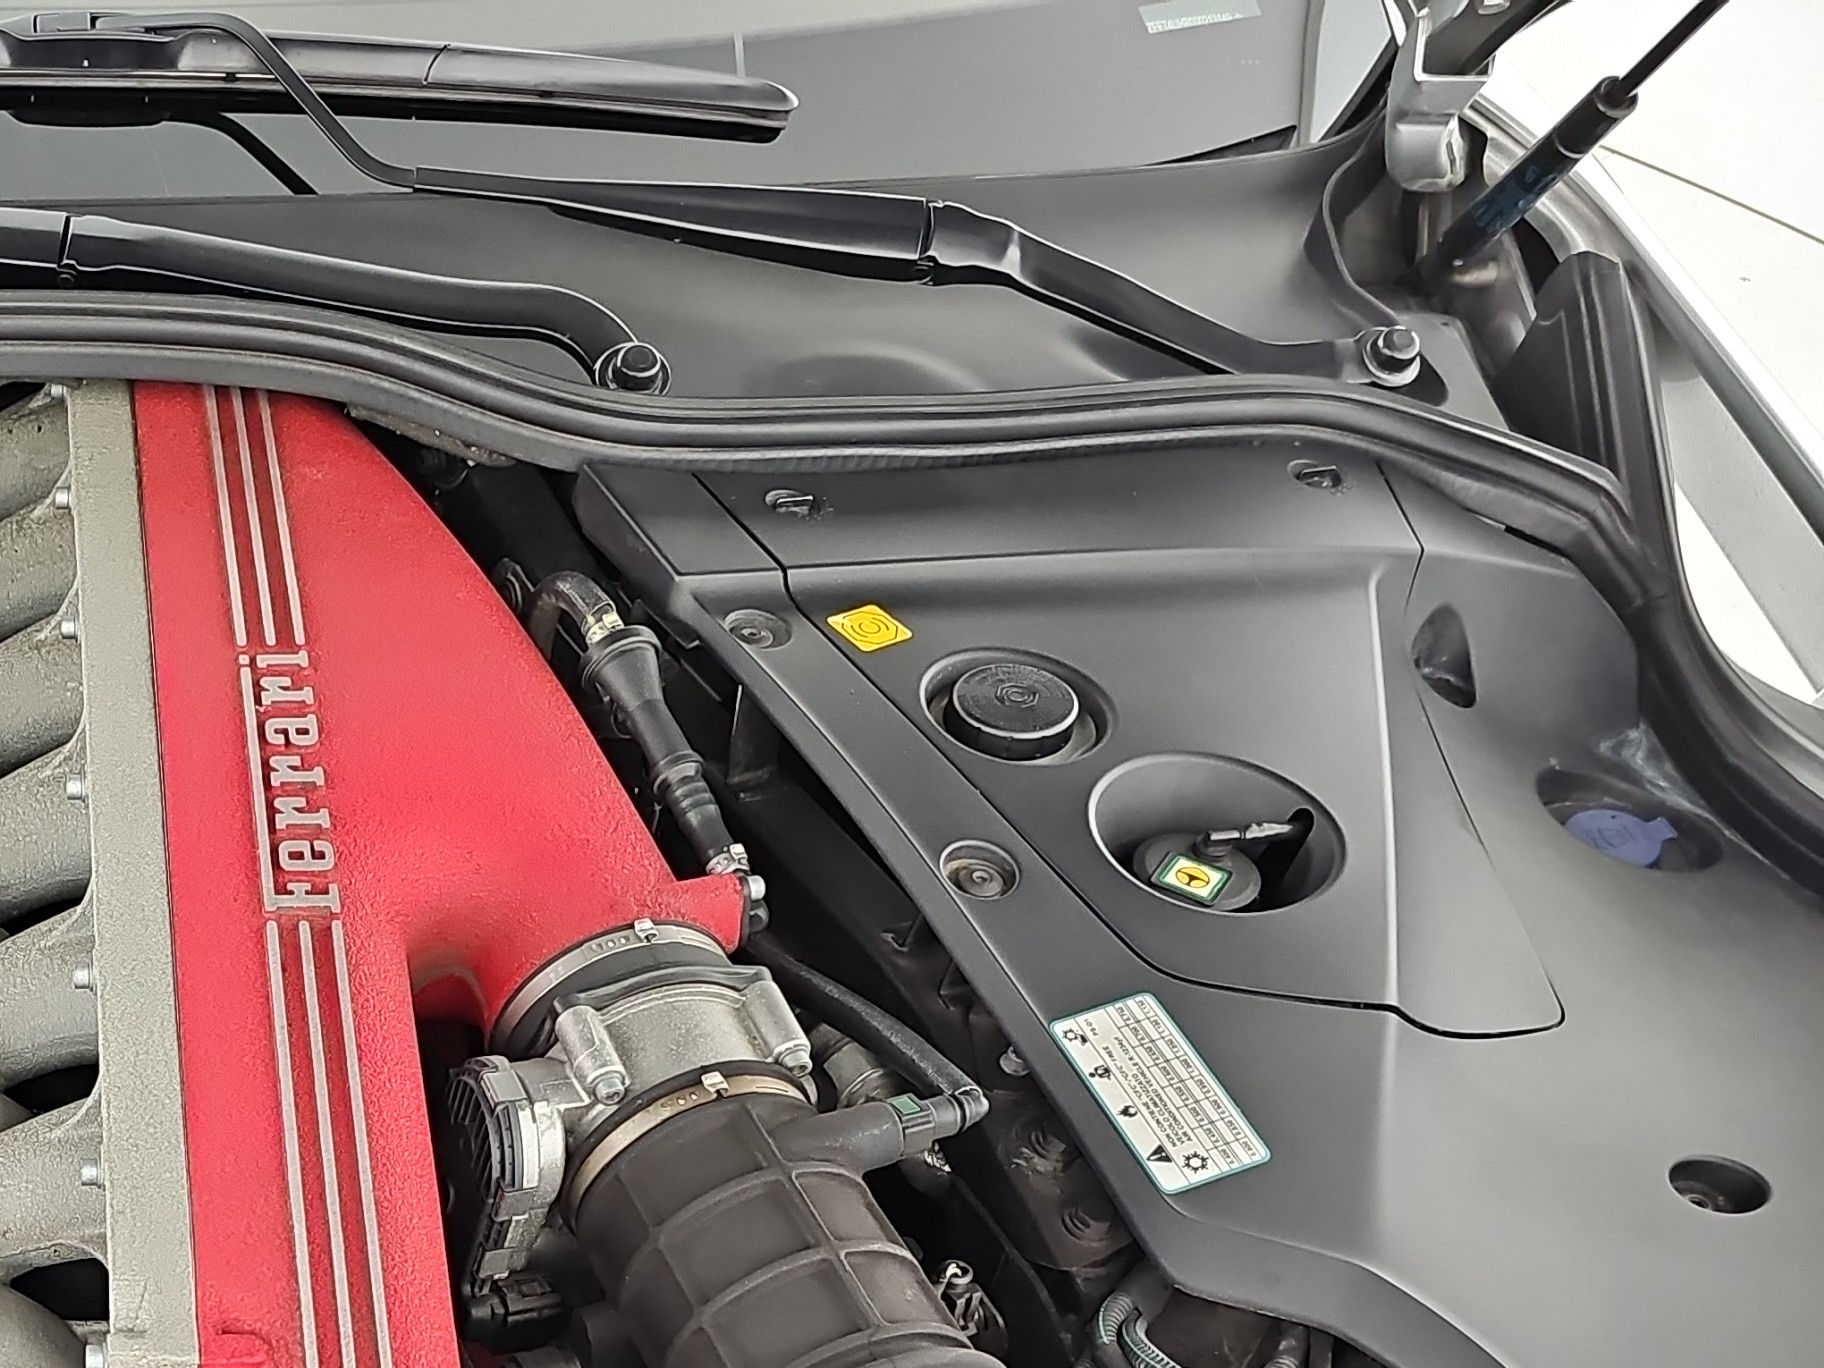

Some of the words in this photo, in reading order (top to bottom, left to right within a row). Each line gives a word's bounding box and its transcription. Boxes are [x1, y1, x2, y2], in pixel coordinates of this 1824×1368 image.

[237, 652, 340, 914] Ferrari
[1101, 1045, 1117, 1062] FREE
[1131, 1061, 1154, 1087] VEHICLE
[1130, 1072, 1166, 1116] CLIMATIZZATO
[1150, 1087, 1185, 1130] CONDITIONED
[1140, 1100, 1167, 1132] CONTIENE
[1161, 1116, 1186, 1145] VEICOLO
[1162, 1132, 1178, 1148] NON
[1180, 1130, 1193, 1142] AIR
